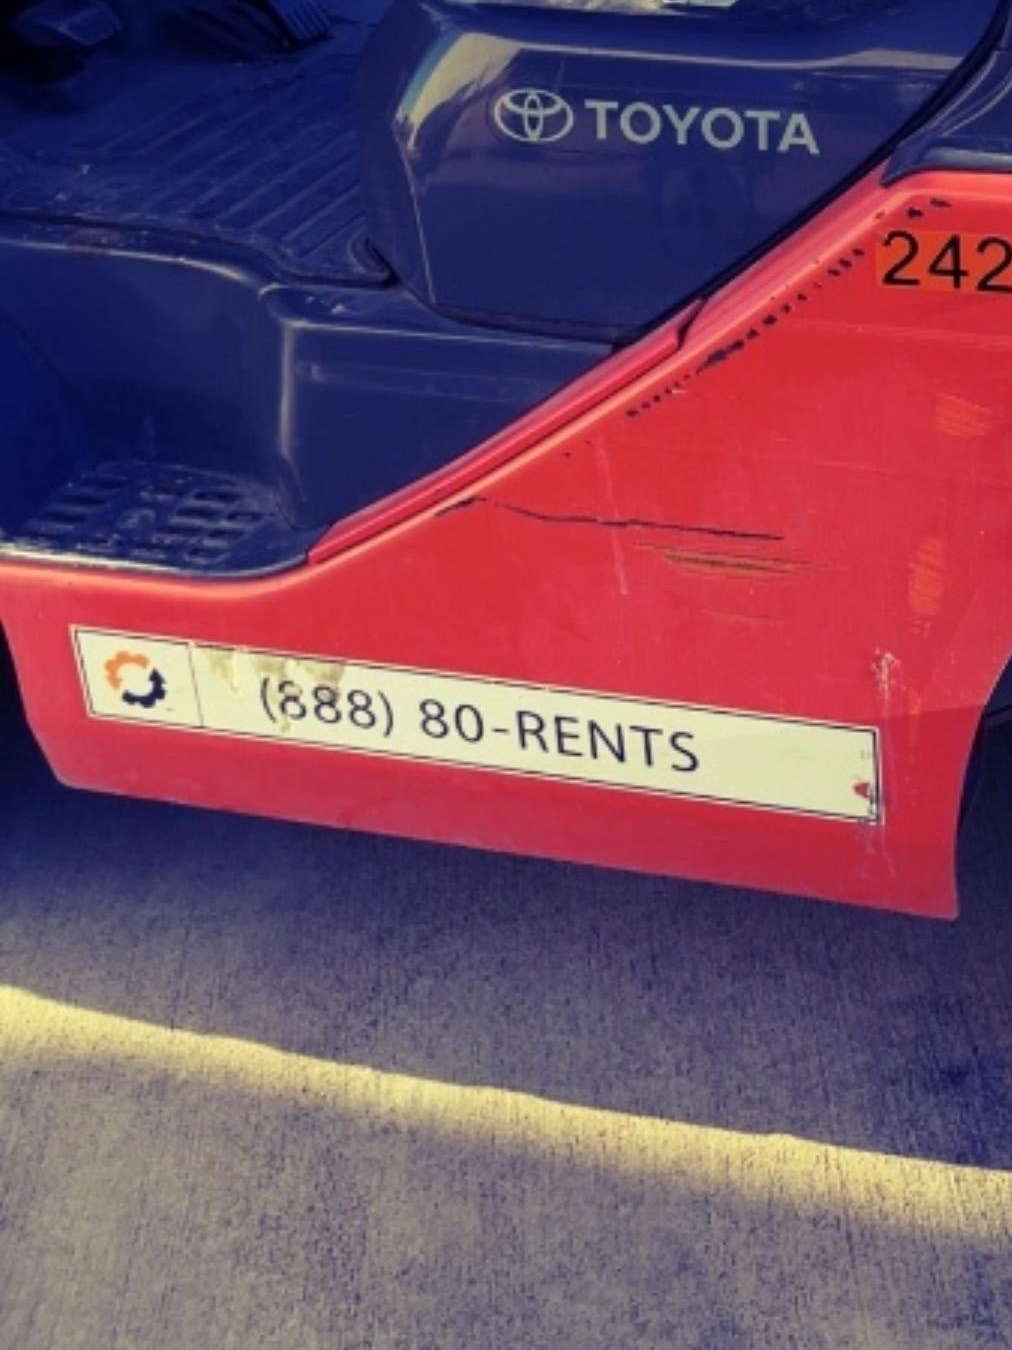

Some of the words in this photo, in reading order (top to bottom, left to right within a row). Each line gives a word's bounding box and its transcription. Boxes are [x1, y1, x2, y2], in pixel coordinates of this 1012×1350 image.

[584, 99, 820, 155] TOYOTA
[260, 677, 394, 738] (888)
[418, 698, 699, 772] 80-RENTS
